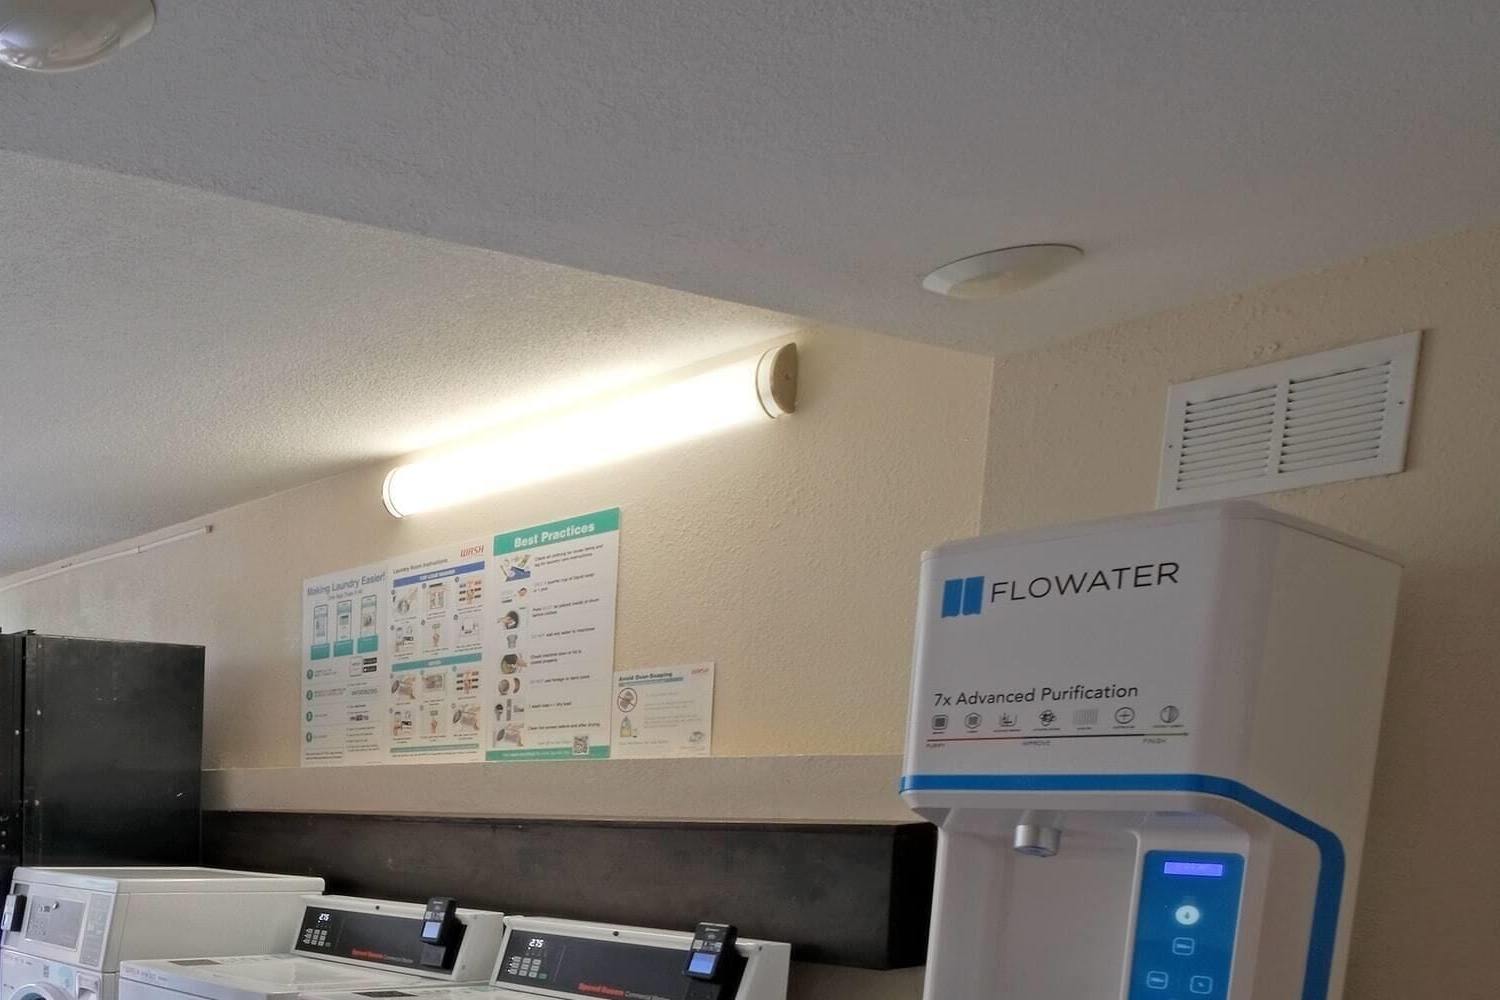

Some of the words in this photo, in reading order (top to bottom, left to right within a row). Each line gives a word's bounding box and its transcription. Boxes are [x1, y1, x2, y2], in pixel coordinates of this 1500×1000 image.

[514, 534, 538, 548] Best
[540, 523, 596, 542] Practices
[332, 579, 360, 592] Laundry
[990, 561, 1181, 603] FLOWATER
[933, 692, 952, 707] 7x
[955, 687, 1036, 706] Advanced
[1041, 683, 1139, 702] Purification
